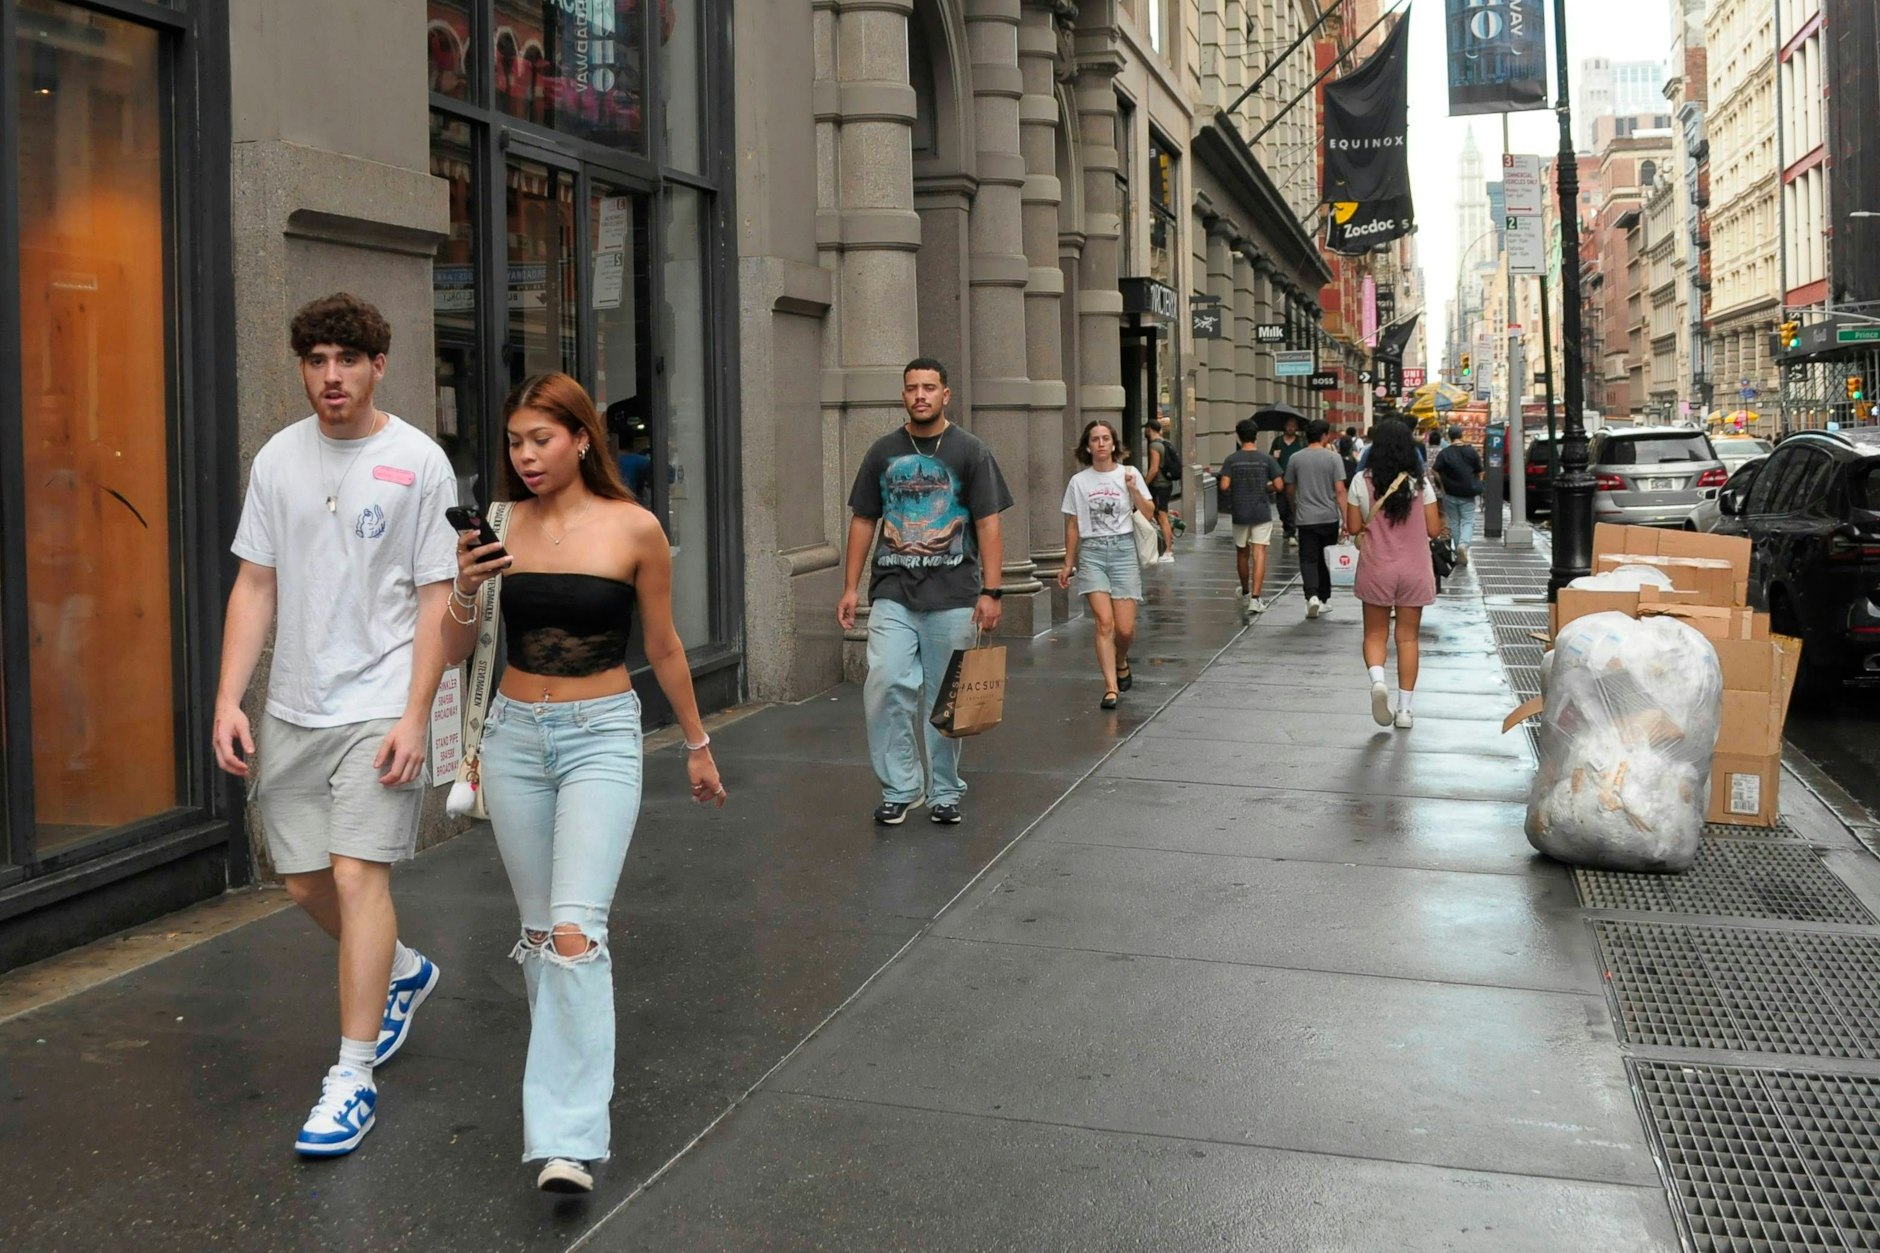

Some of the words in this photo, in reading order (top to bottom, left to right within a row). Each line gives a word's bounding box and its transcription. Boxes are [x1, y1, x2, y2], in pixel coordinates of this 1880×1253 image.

[1329, 135, 1404, 151] EQUINOX
[1504, 155, 1513, 167] 3
[1343, 218, 1396, 238] Zocdoc
[1508, 217, 1517, 229] 2
[1258, 325, 1284, 338] Milk
[1855, 331, 1879, 339] Prince
[1403, 370, 1420, 378] UNI
[1403, 378, 1421, 387] QLO
[1492, 436, 1501, 448] P
